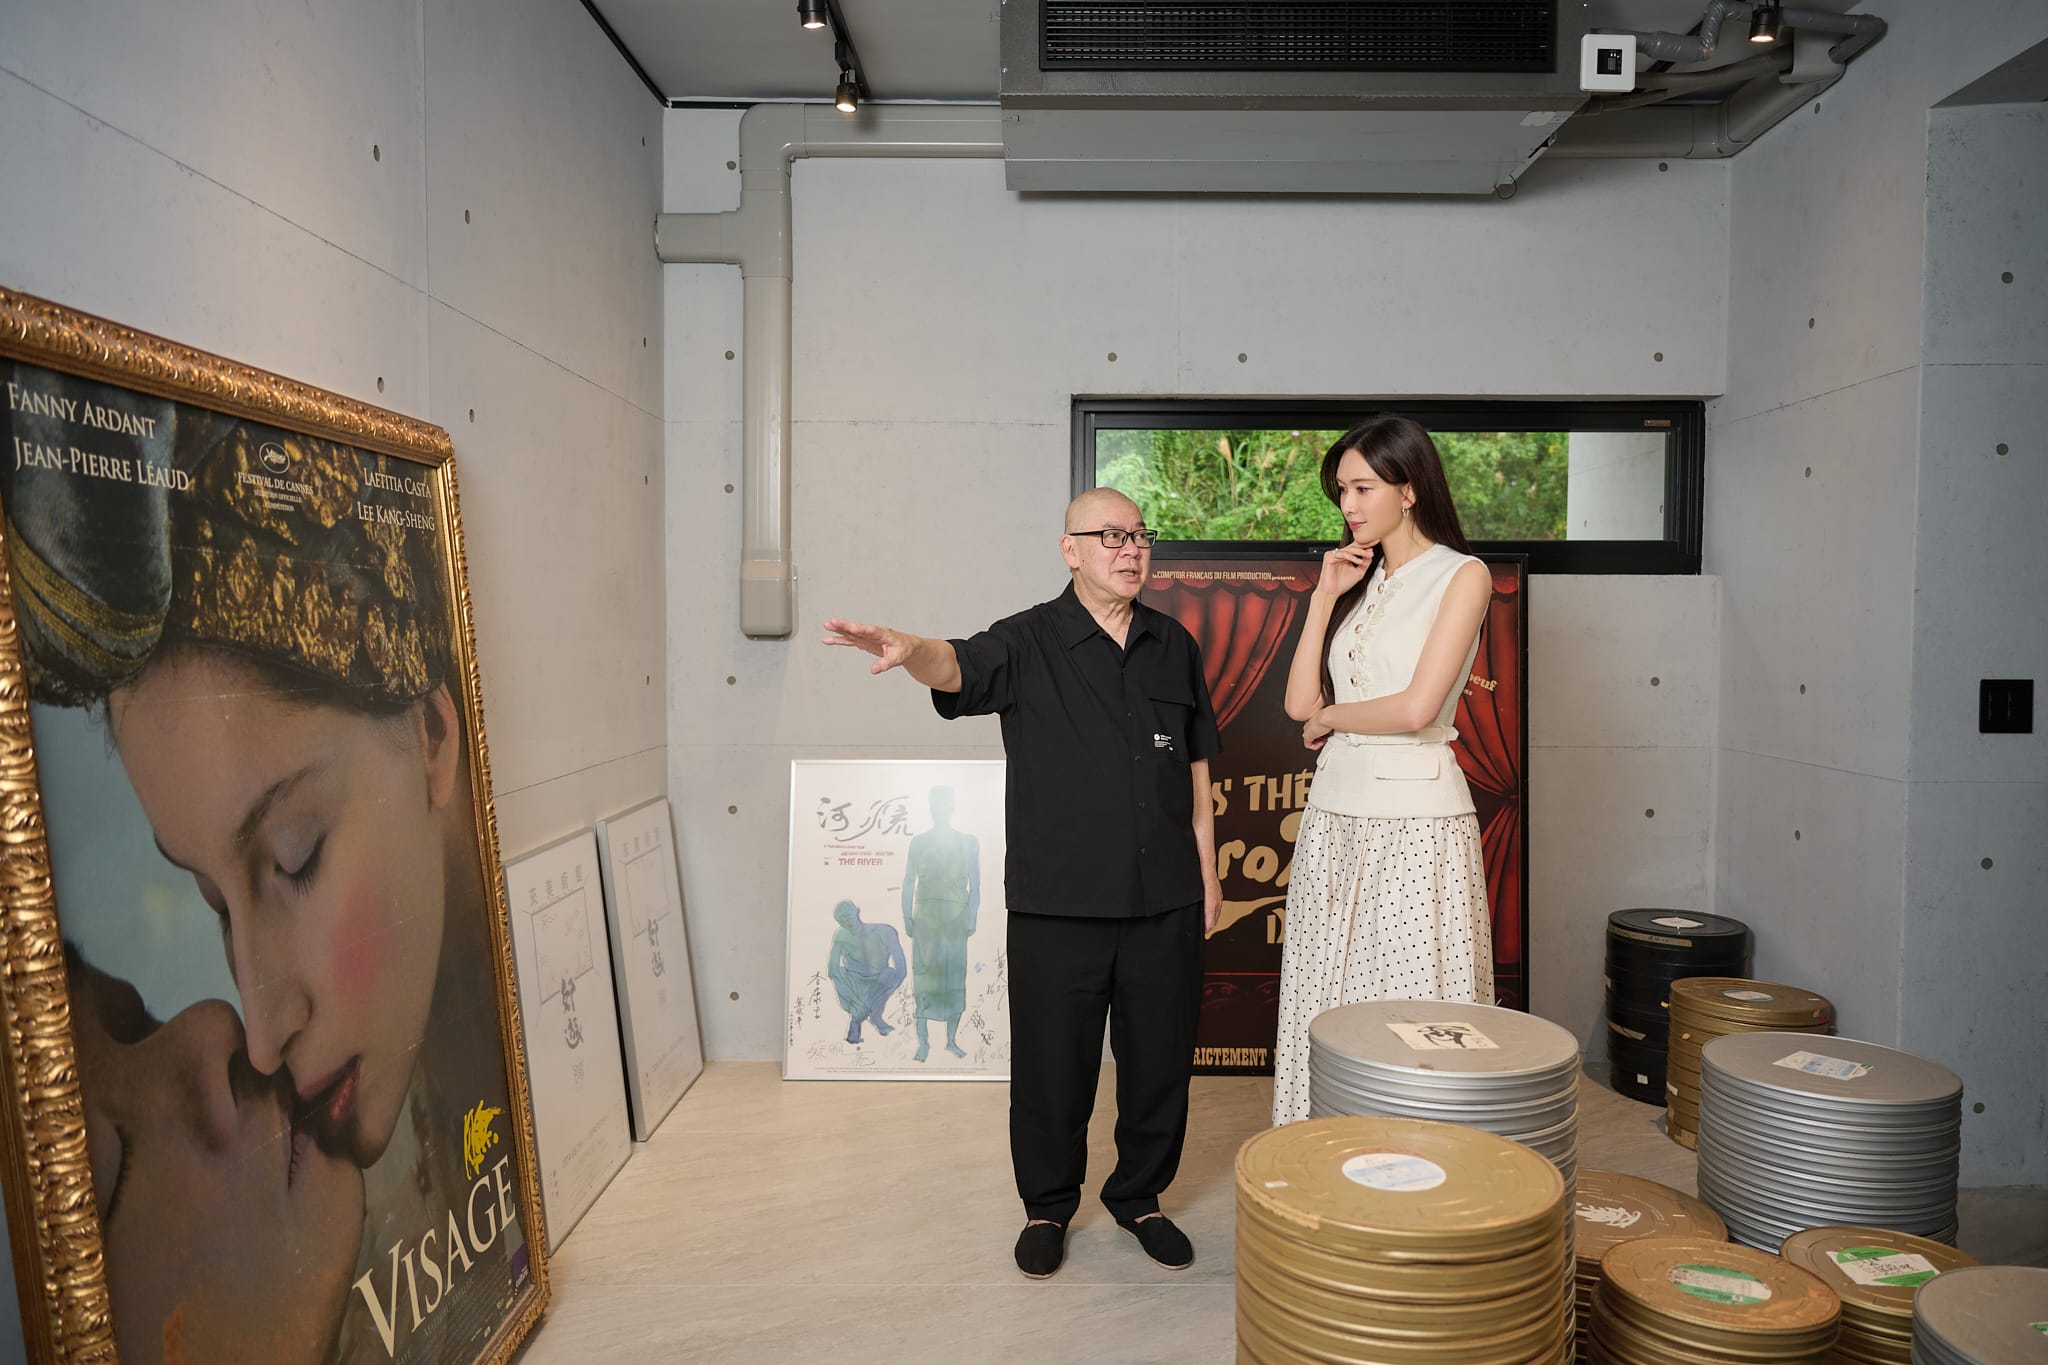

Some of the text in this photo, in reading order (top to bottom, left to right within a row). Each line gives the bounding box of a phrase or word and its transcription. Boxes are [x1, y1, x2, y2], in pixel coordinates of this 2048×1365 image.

[7, 382, 155, 439] FANNY ARDANT
[13, 436, 190, 491] JEAN-PIERRE LÉAUD
[238, 472, 314, 496] FESTIVAL DE CANNES
[363, 467, 432, 499] LAETITIA CASTA
[357, 501, 435, 531] LEE KANG-SHENG
[1157, 570, 1186, 579] COMPTOIR
[1186, 571, 1213, 580] FRANÇAIS
[1214, 571, 1222, 579] DU
[1223, 571, 1236, 580] FILM
[1236, 571, 1272, 580] PRODUCTION
[839, 858, 856, 866] THE
[857, 858, 883, 866] RIVER
[352, 1154, 516, 1359] VISAGE
